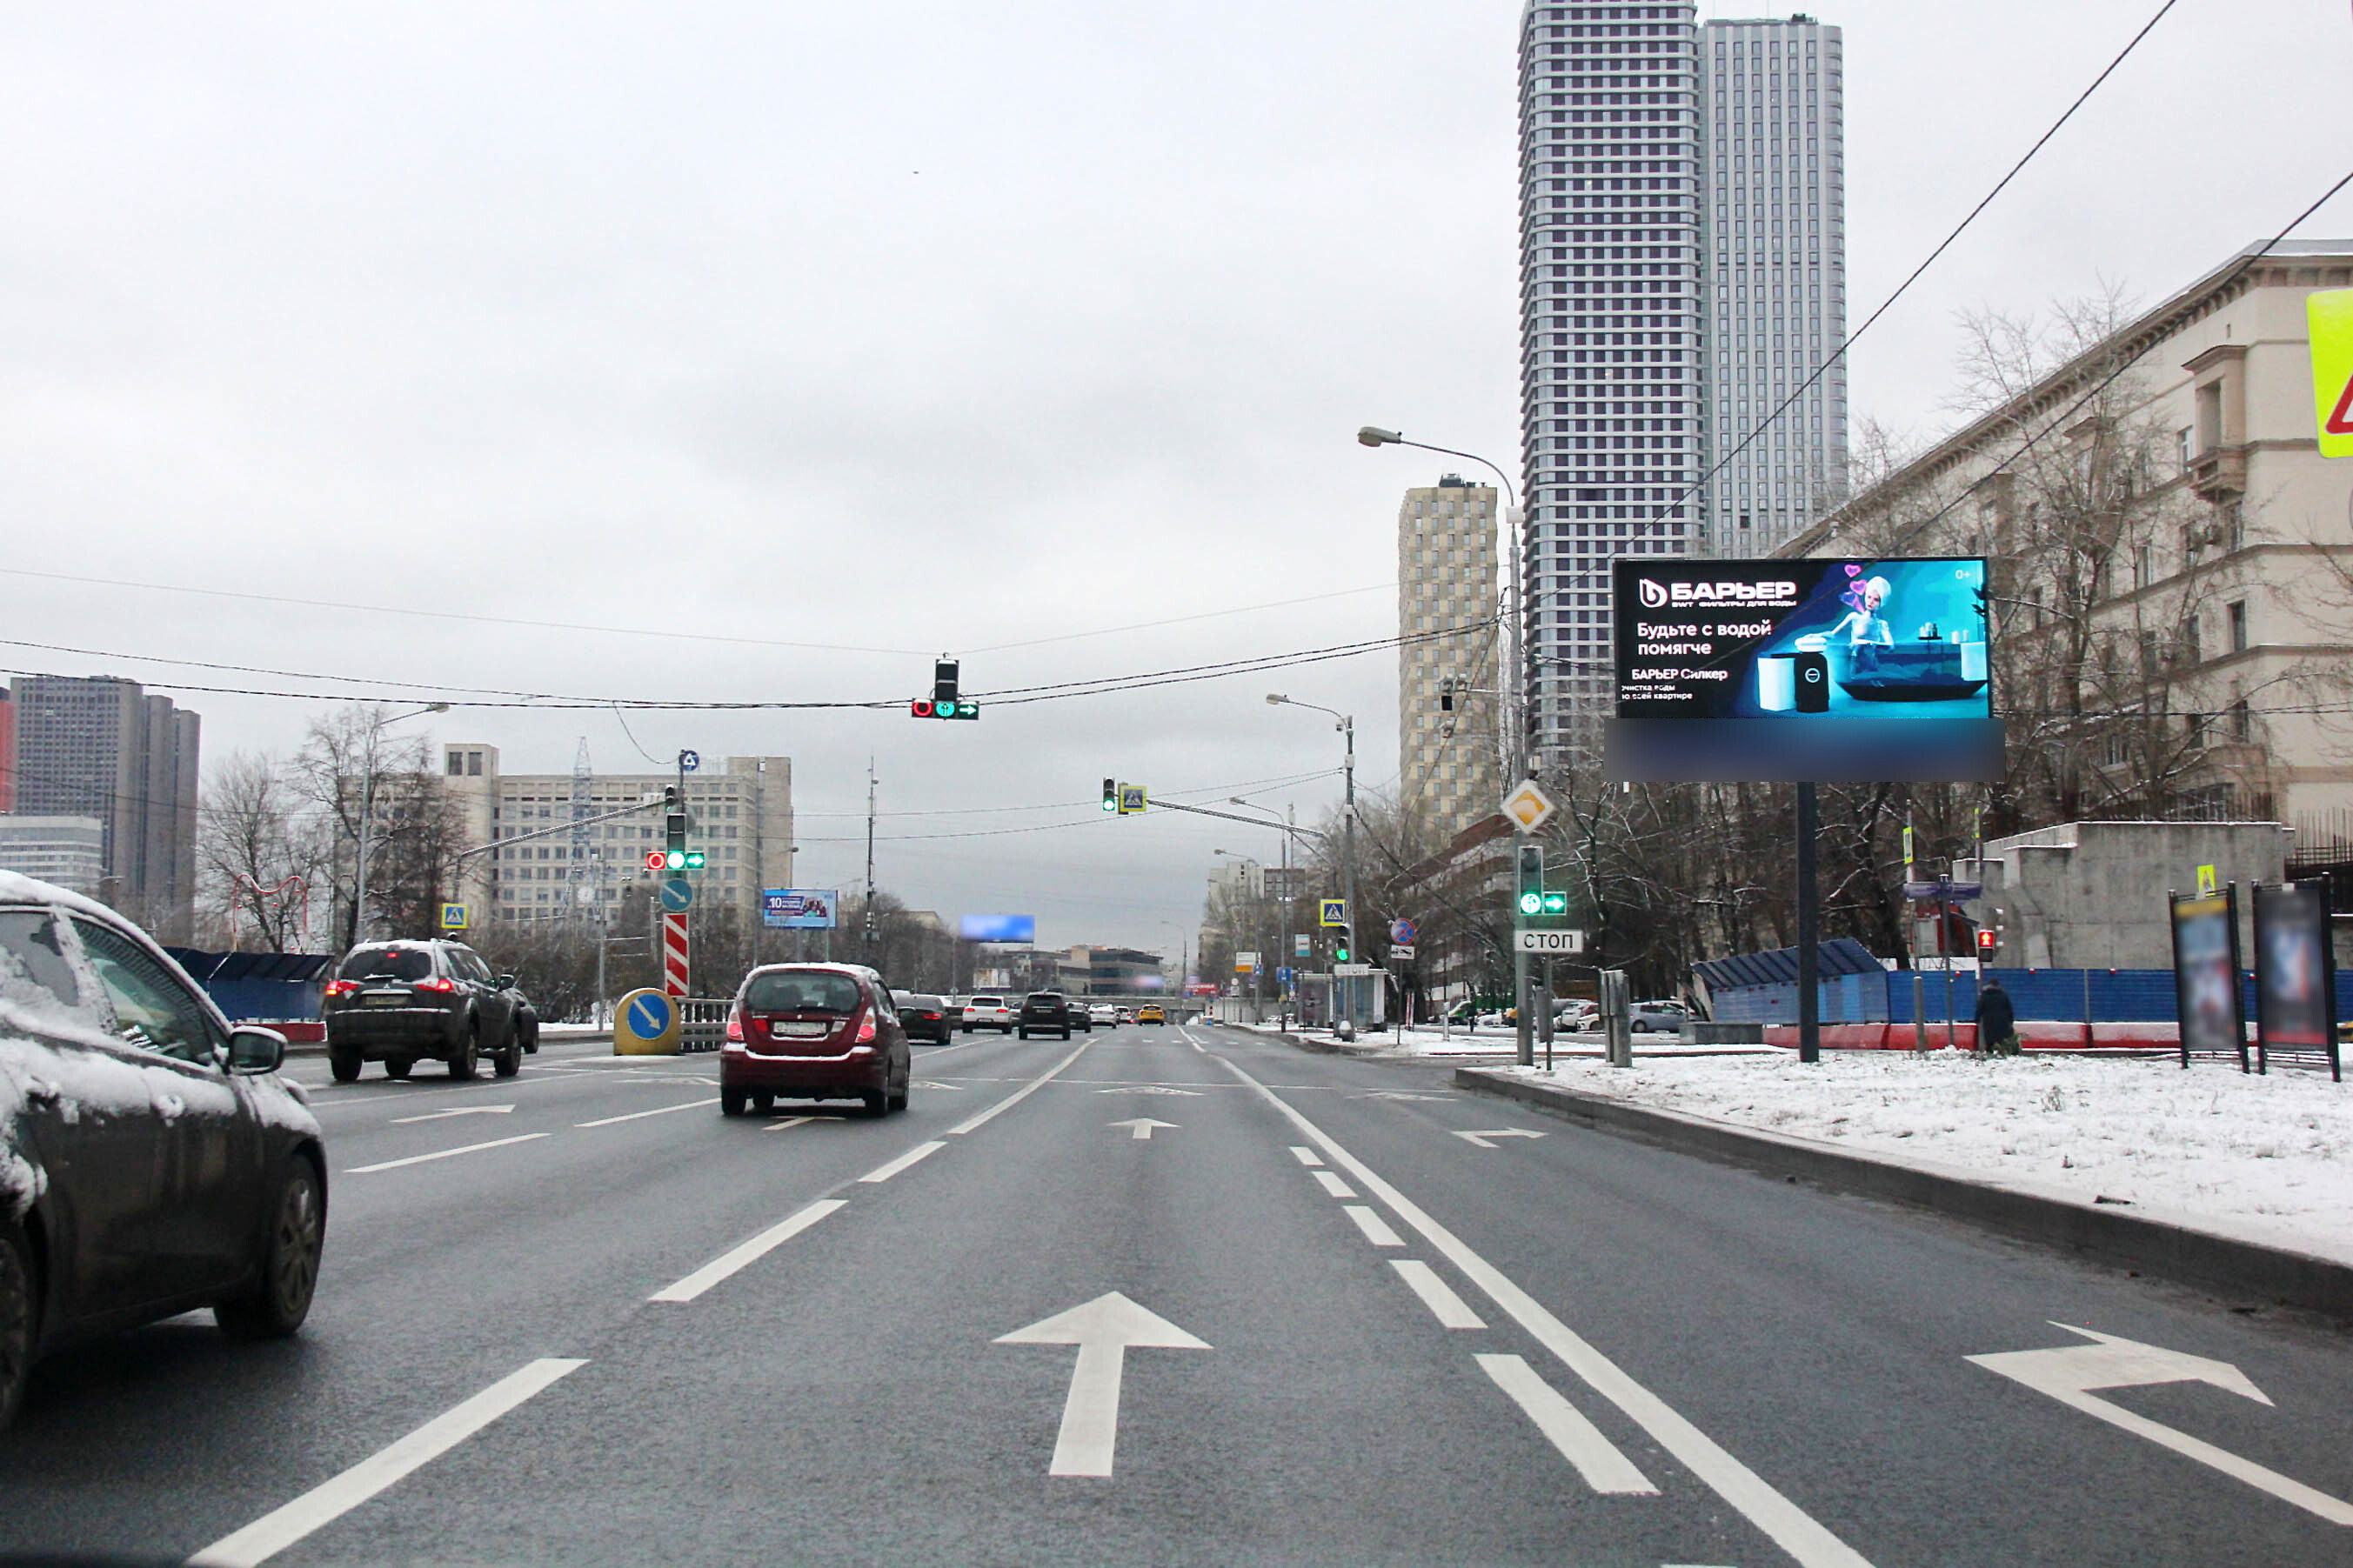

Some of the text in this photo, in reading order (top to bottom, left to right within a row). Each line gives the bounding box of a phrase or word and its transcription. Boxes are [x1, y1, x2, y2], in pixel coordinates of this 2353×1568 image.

[1670, 581, 1797, 600] БАРЬЕР
[1637, 618, 1773, 640] Будьте с водой
[1638, 643, 1713, 656] помягче
[1631, 669, 1728, 682] БАРЬЕР Силкер
[1523, 933, 1574, 949] СТОП
